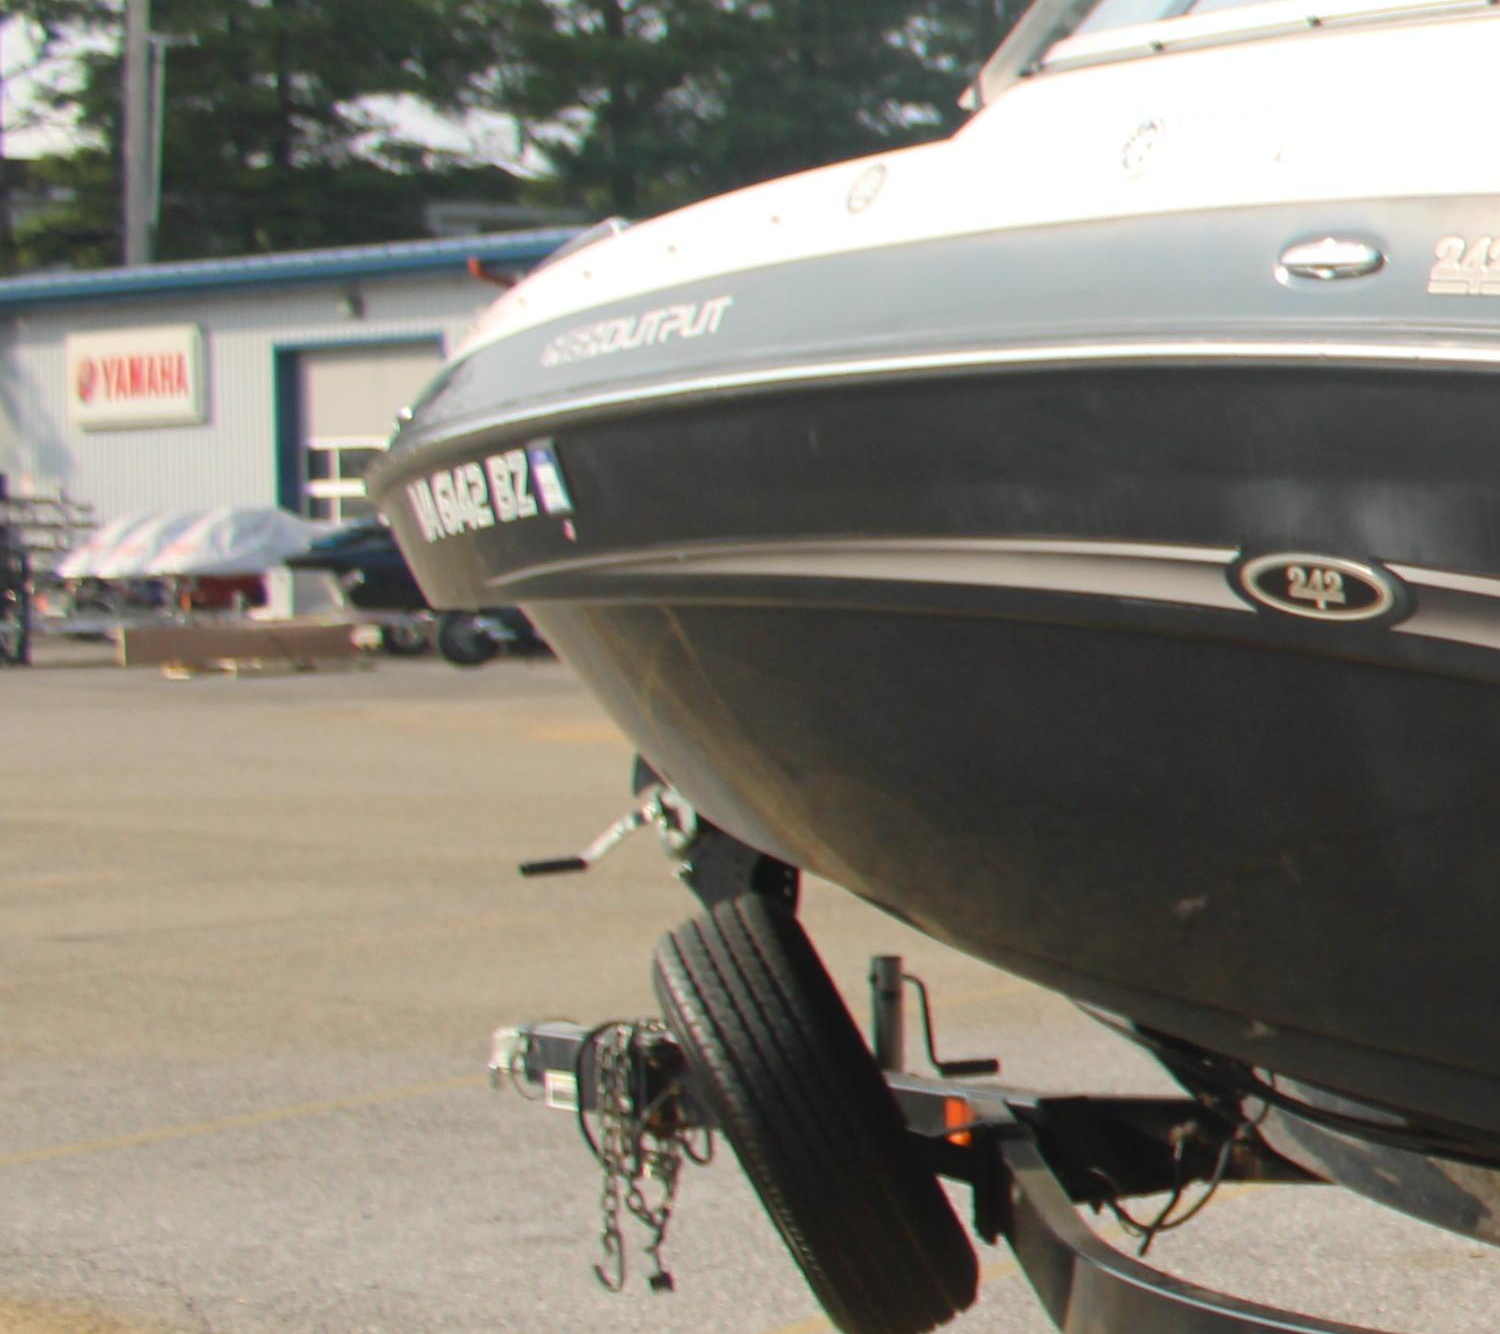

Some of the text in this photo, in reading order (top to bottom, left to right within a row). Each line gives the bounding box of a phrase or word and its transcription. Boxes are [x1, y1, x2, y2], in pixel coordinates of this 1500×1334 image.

[102, 350, 188, 402] YAMAHA
[485, 448, 538, 523] BZ
[1286, 565, 1346, 610] 242
